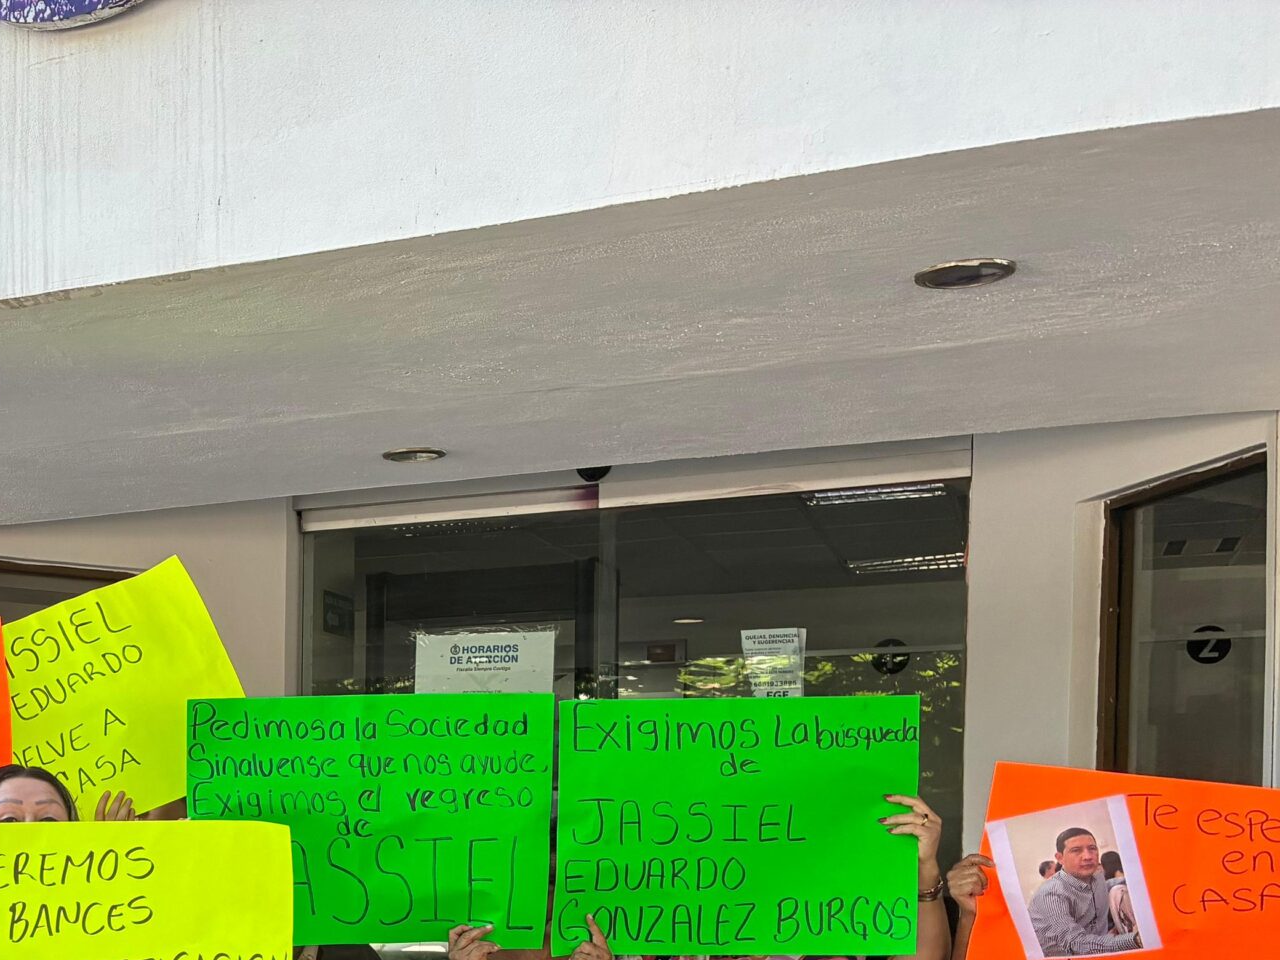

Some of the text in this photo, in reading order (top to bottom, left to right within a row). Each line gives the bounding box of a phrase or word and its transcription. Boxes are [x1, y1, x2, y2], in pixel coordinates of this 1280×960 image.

[449, 655, 464, 665] DE
[461, 643, 520, 655] HORARIOS
[10, 644, 144, 722] EDUARDO
[103, 707, 127, 737] A
[386, 708, 529, 739] Sociedad
[572, 702, 762, 753] Exigimos
[347, 752, 398, 779] que
[403, 752, 453, 777] nos
[720, 751, 763, 778] de
[192, 780, 534, 819] Exigimos el regreso
[1126, 793, 1180, 831] Te
[336, 815, 374, 838] de
[571, 798, 808, 846] JASSIEL
[564, 856, 748, 894] EDUARDO
[1222, 850, 1276, 876] en
[557, 895, 913, 946] GONZALEZ BURGOS
